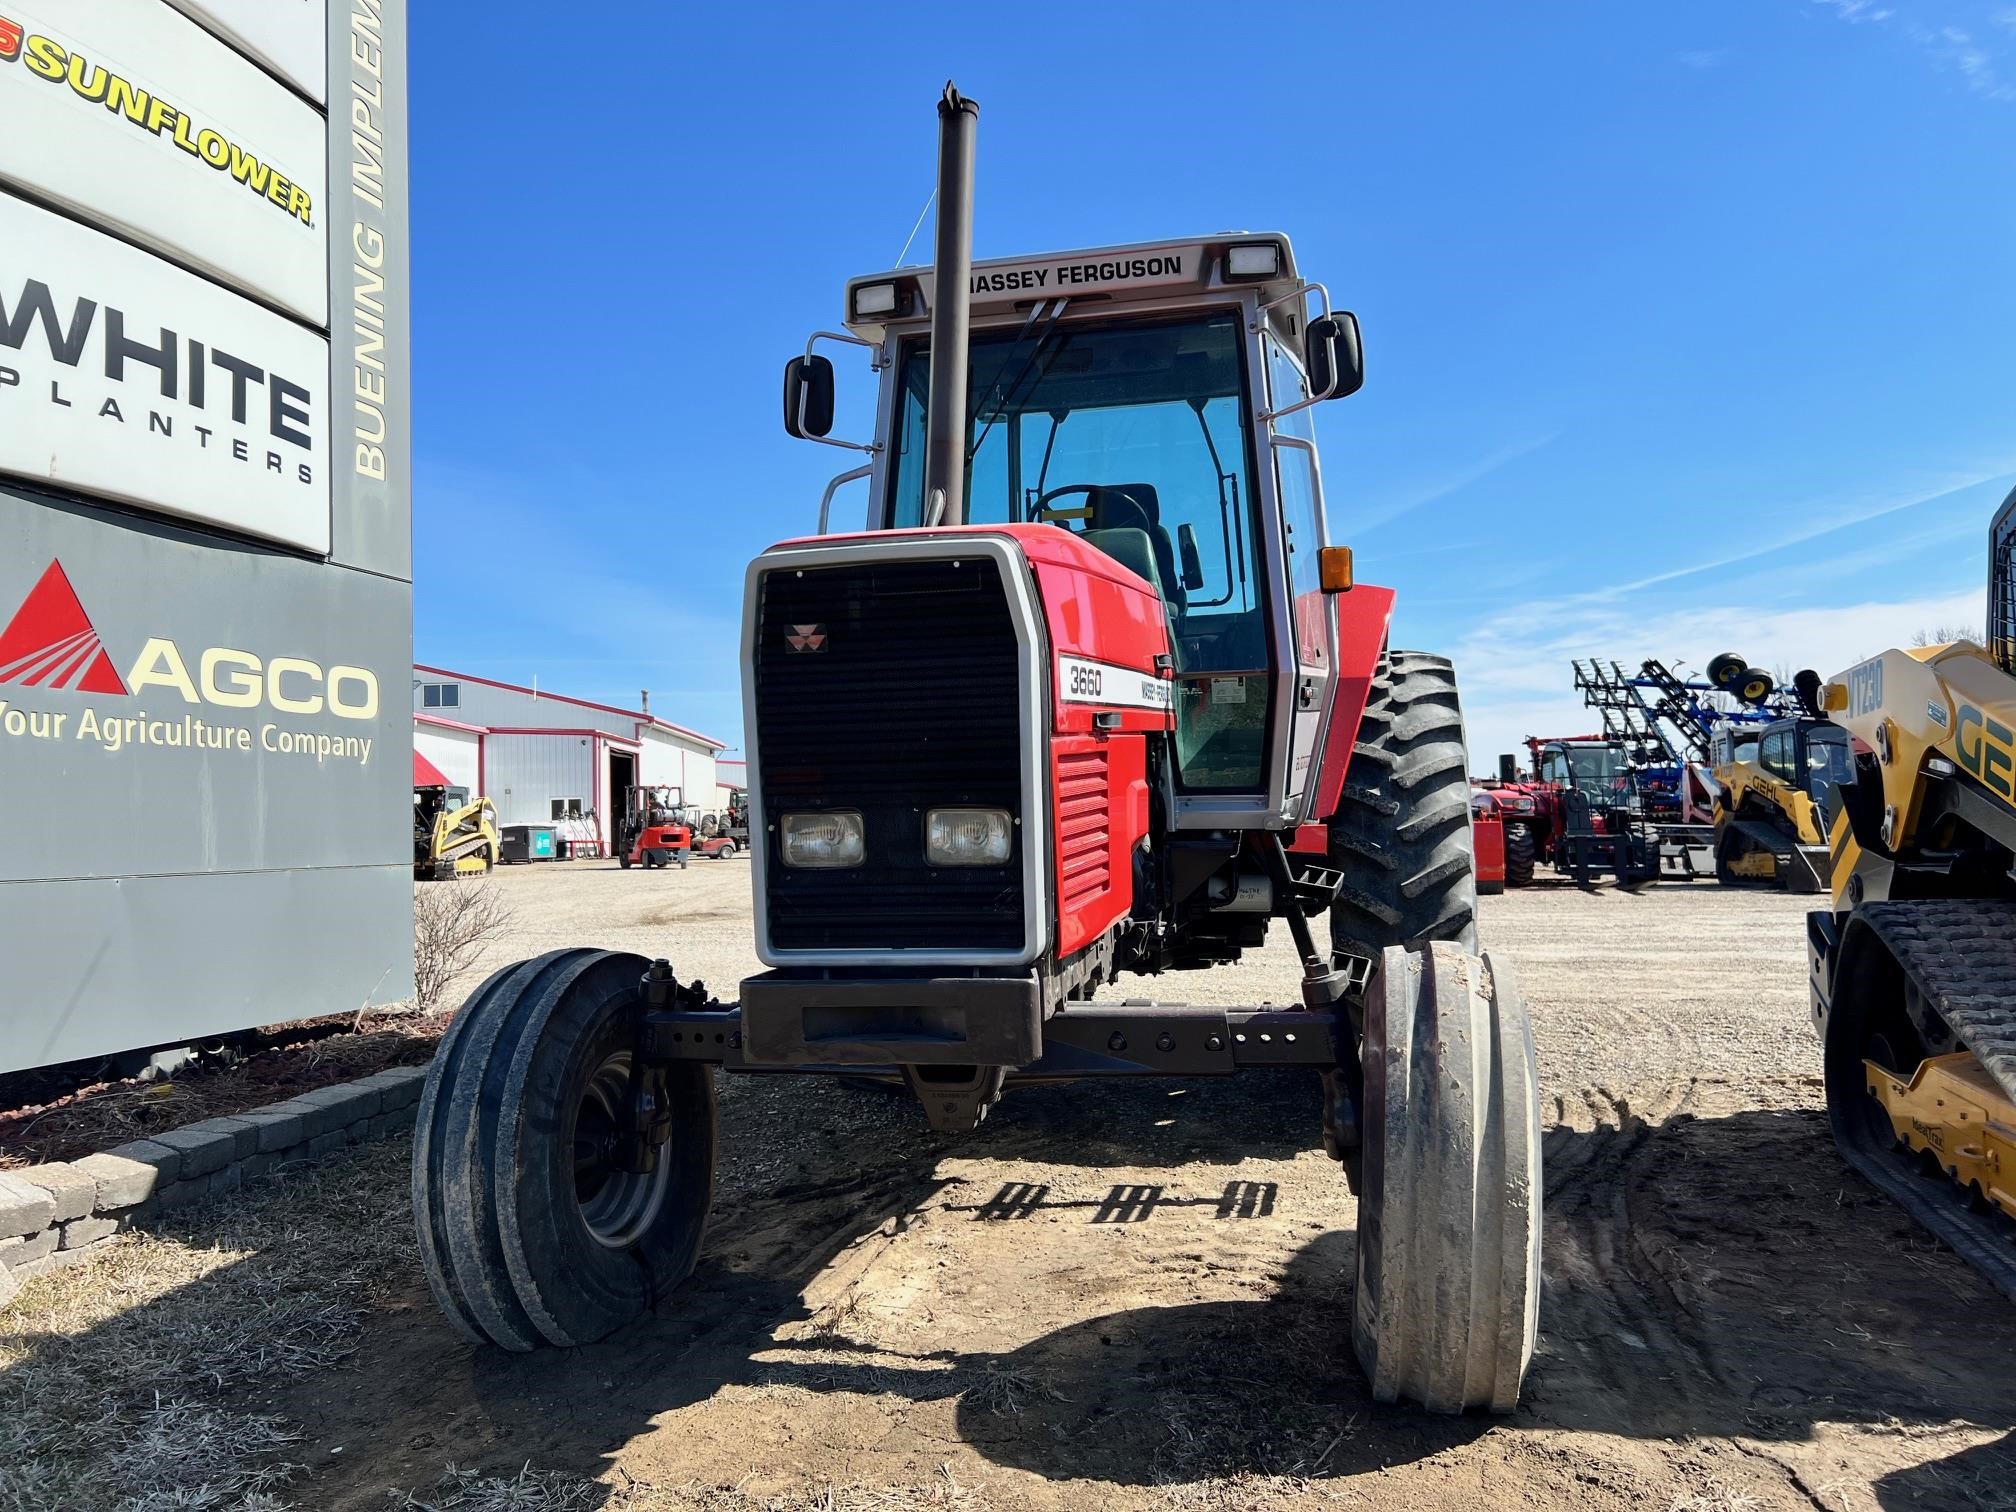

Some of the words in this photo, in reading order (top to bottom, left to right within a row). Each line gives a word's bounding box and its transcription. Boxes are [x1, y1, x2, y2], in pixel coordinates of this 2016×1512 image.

[23, 34, 312, 227] SUNFLOWER
[1057, 255, 1183, 286] FERGUSON
[0, 278, 312, 451] WHITE
[352, 226, 387, 482] BUENING
[127, 637, 380, 720] AGCO
[1070, 665, 1102, 697] 3660
[76, 707, 252, 752] Agriculture
[262, 724, 373, 765] Company
[1753, 775, 1780, 803] GEHL
